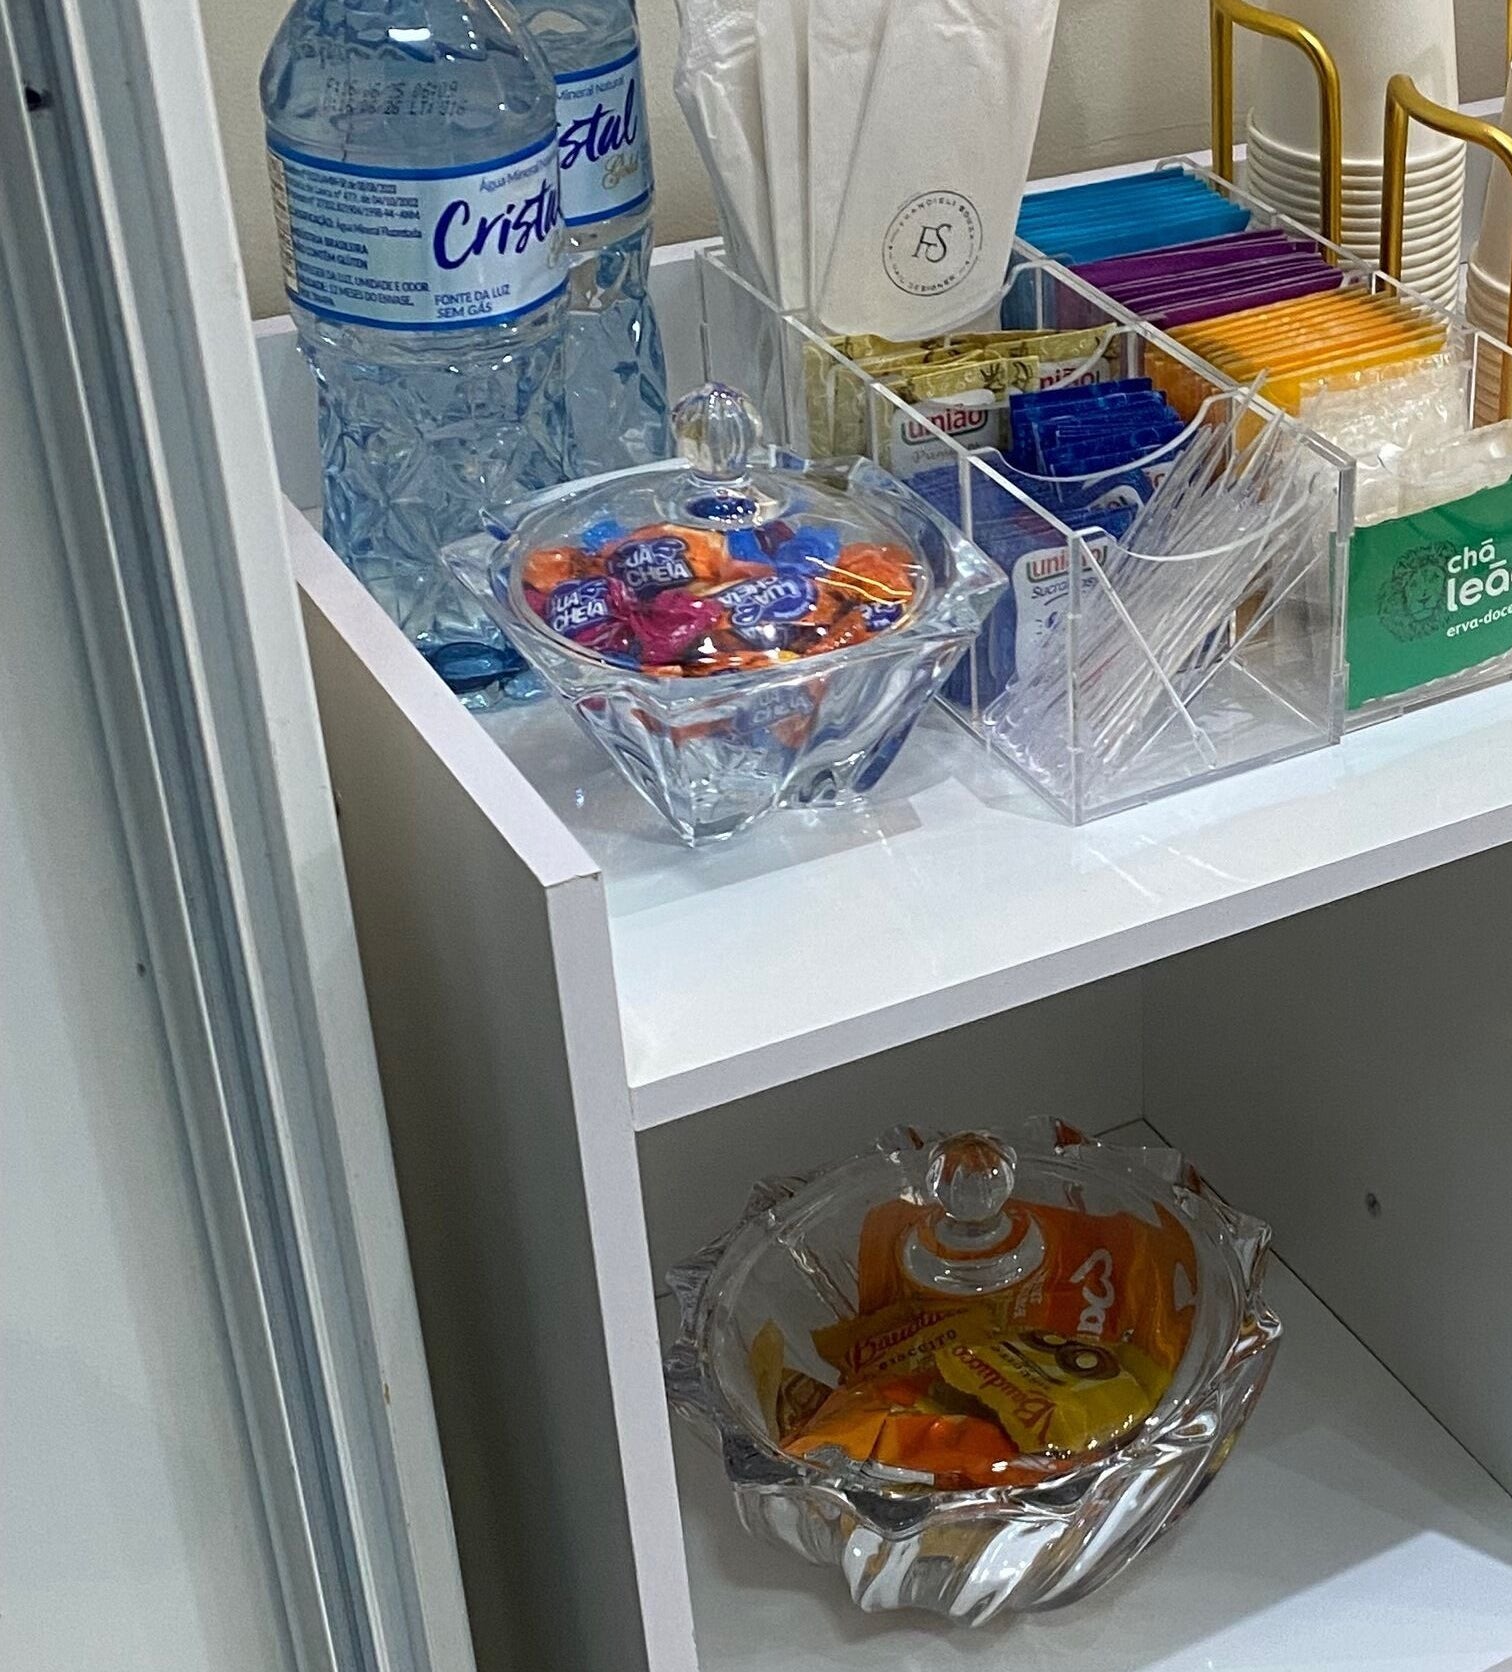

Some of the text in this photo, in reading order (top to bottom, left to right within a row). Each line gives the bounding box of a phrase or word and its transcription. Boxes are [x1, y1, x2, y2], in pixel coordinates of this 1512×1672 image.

[595, 75, 625, 92] Natural
[558, 78, 638, 170] stal
[479, 176, 506, 193] Água
[911, 223, 952, 263] FS
[339, 286, 363, 300] MESES
[365, 291, 377, 302] DO
[355, 276, 393, 291] UMIDADE
[395, 281, 400, 292] E
[434, 283, 511, 306] FONTE DA LUZ
[437, 301, 493, 319] SEM GÁS
[1447, 538, 1497, 574] chá
[627, 559, 693, 588] CHEIA
[755, 581, 797, 606] LUA
[554, 600, 606, 632] CHEIA
[953, 1346, 1056, 1443] Bauducco
